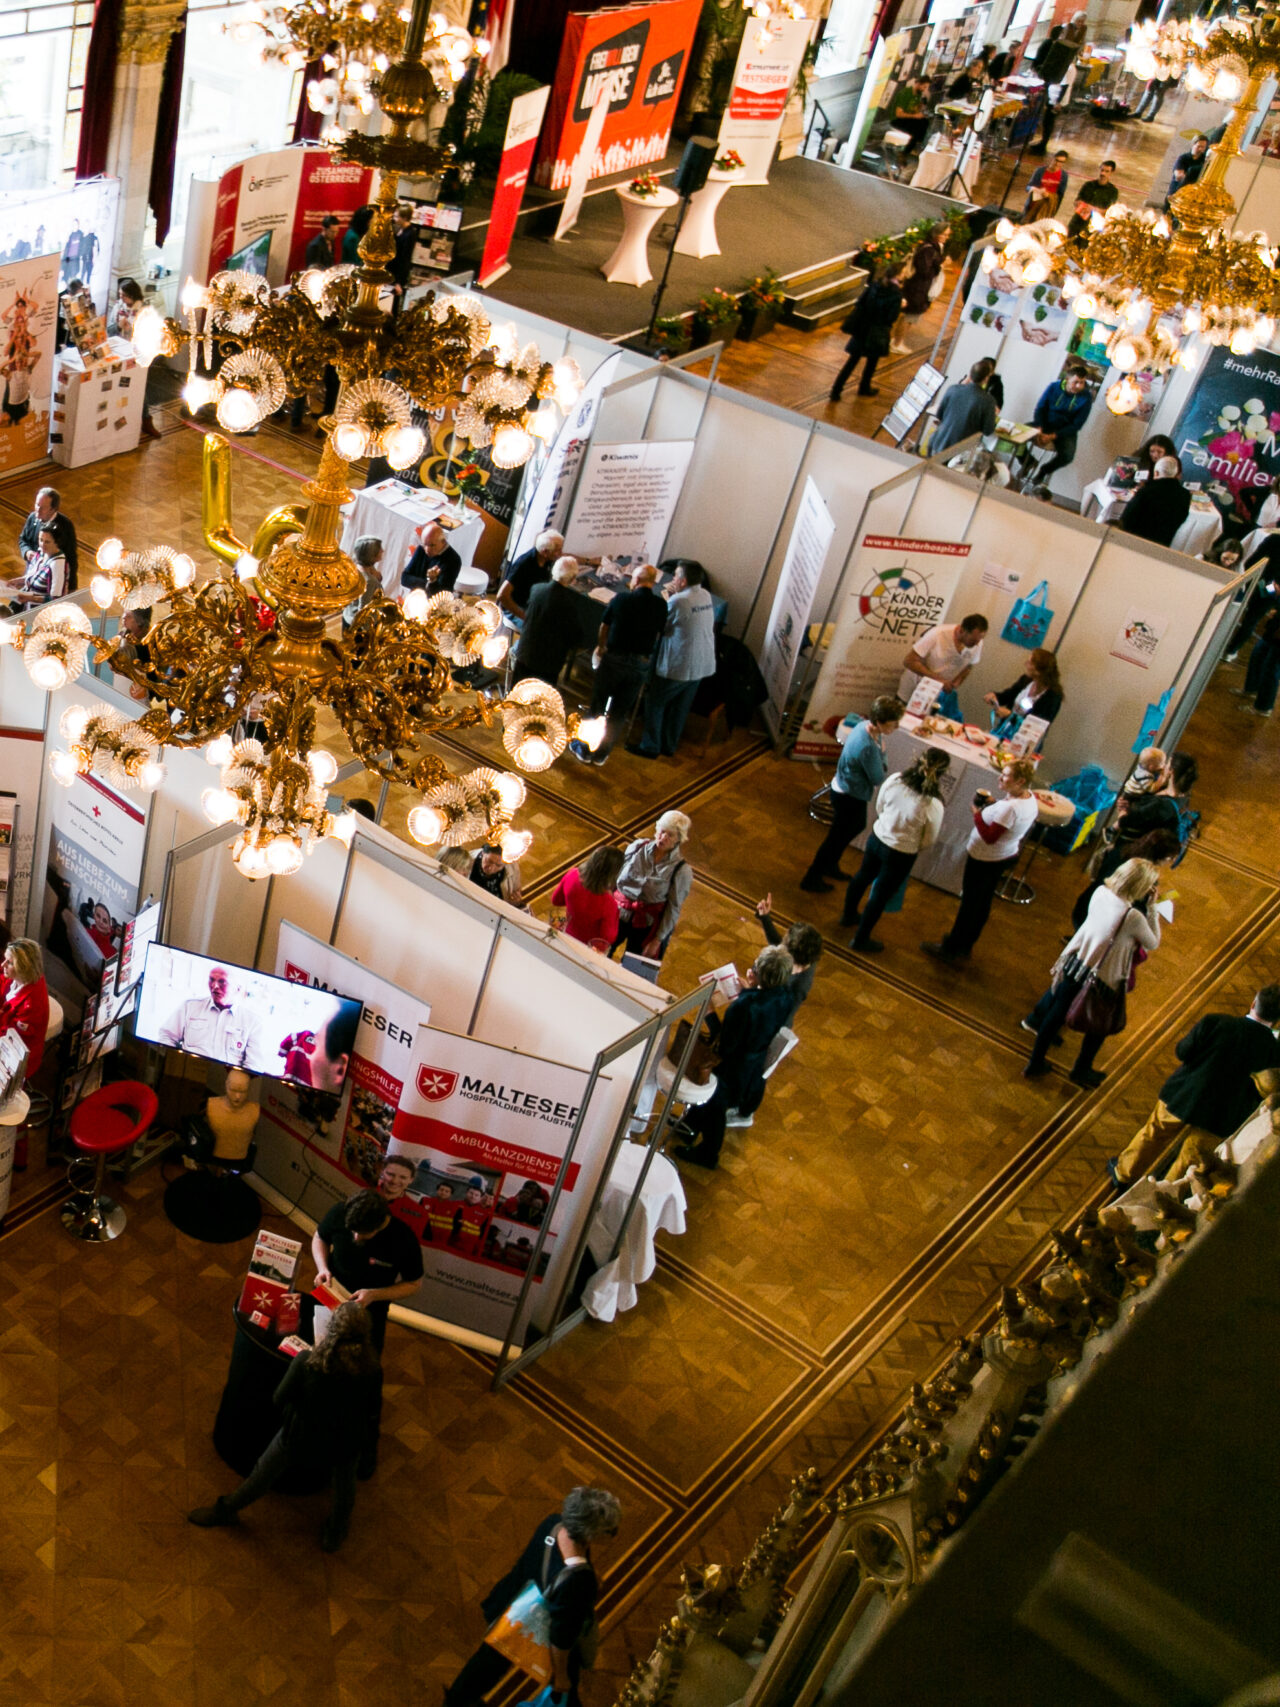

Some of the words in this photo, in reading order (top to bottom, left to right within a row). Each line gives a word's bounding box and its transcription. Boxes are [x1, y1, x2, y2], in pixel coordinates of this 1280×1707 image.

[865, 539, 969, 554] www.kinderhospiz.at
[57, 840, 77, 859] AUS
[78, 854, 103, 878] LIEBE
[103, 873, 128, 899] ZUM
[459, 1090, 538, 1118] HOSPITALDIENST
[539, 1113, 576, 1129] AUSTRI
[449, 1133, 562, 1171] AMBULANZDIENST
[436, 1268, 520, 1300] www.malteser.a
